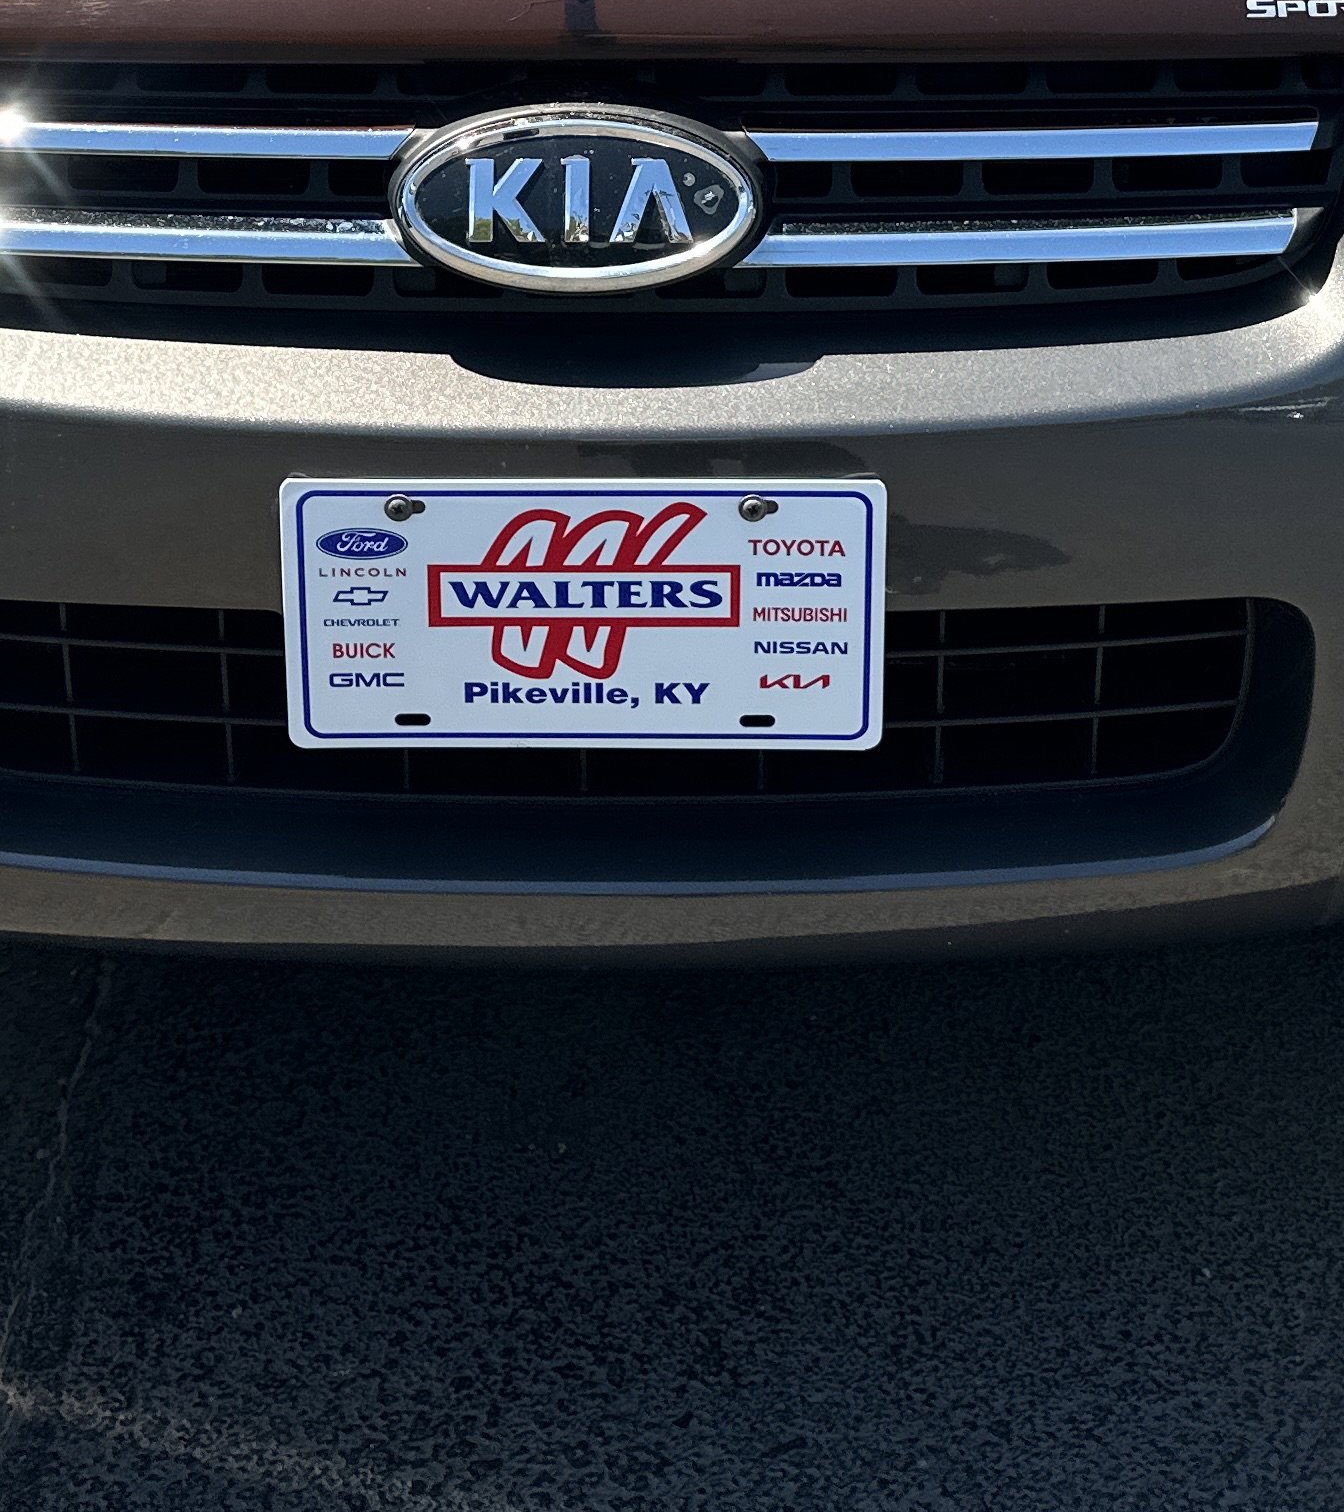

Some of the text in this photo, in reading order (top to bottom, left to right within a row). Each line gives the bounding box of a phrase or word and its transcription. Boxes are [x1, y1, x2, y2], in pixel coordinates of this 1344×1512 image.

[464, 157, 694, 244] KIA
[336, 531, 390, 552] Ford
[748, 539, 846, 557] TOYOTA
[318, 567, 407, 578] LINCOLN
[448, 580, 723, 609] WALTERS
[323, 618, 400, 627] CHEVROLET
[752, 607, 847, 623] MITSUBISHI
[332, 642, 396, 659] BUICK
[754, 641, 848, 655] NISSAN
[329, 672, 405, 688] GMC
[759, 674, 830, 689] KIA
[464, 682, 710, 708] Pikeville, KY
